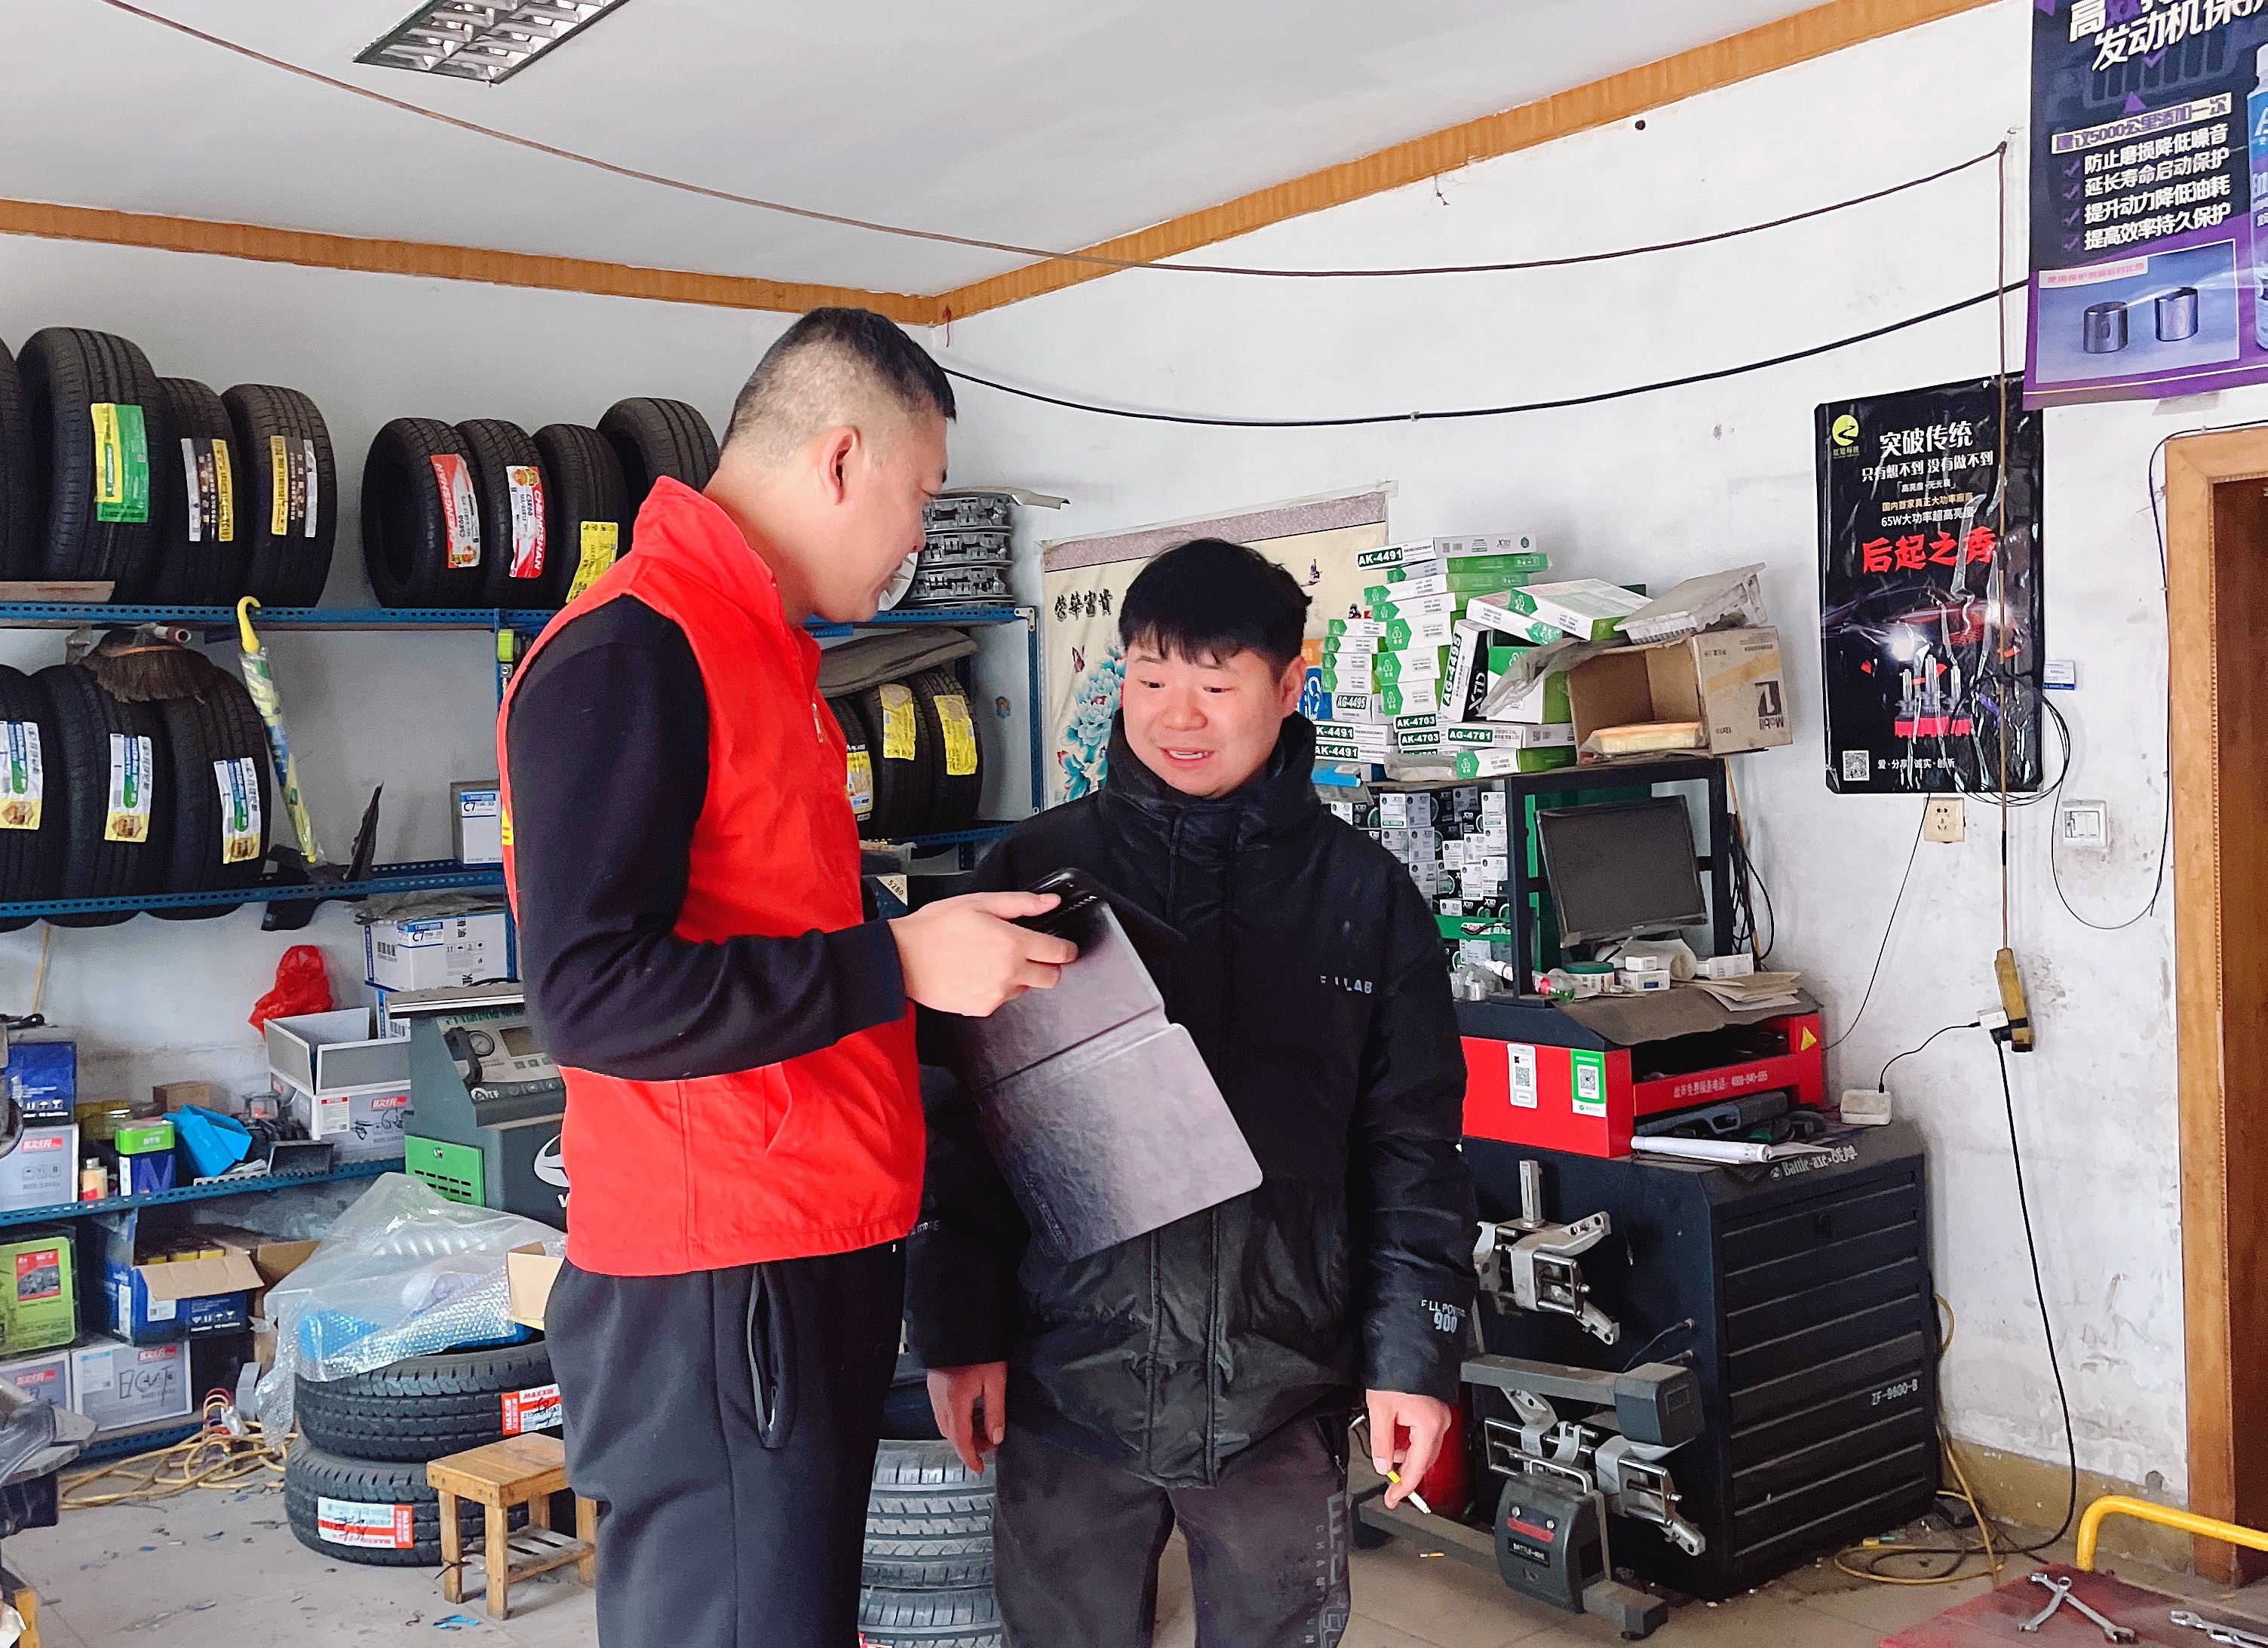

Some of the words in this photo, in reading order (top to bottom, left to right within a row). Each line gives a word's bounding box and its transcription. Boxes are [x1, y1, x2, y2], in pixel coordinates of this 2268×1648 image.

[2084, 123, 2229, 175] 防止磨损降低噪音
[2084, 146, 2230, 198] 延长寿命启动保护
[2084, 173, 2230, 225] 提升动力降低油耗
[2084, 201, 2231, 251] 提高效率持久保护
[1879, 420, 1973, 459] 突破传统
[1861, 462, 1924, 483] 只有想不到
[1927, 450, 1993, 474] 没有做不到
[1880, 506, 1975, 527] 65W大功率超高亮度
[1358, 549, 1403, 566] AK-4491
[1861, 526, 1997, 574] 后起之秀
[1444, 634, 1461, 705] AG-4495
[1315, 726, 1354, 738] K-4491
[1397, 716, 1435, 729] AK-4703
[1760, 717, 1785, 731] Mobil
[1401, 733, 1440, 745] AK-4703
[1449, 729, 1493, 741] AG-4781
[1315, 745, 1358, 758] AK-4491
[464, 803, 476, 812] C7
[413, 931, 425, 942] C7
[1434, 1312, 1458, 1333] 900
